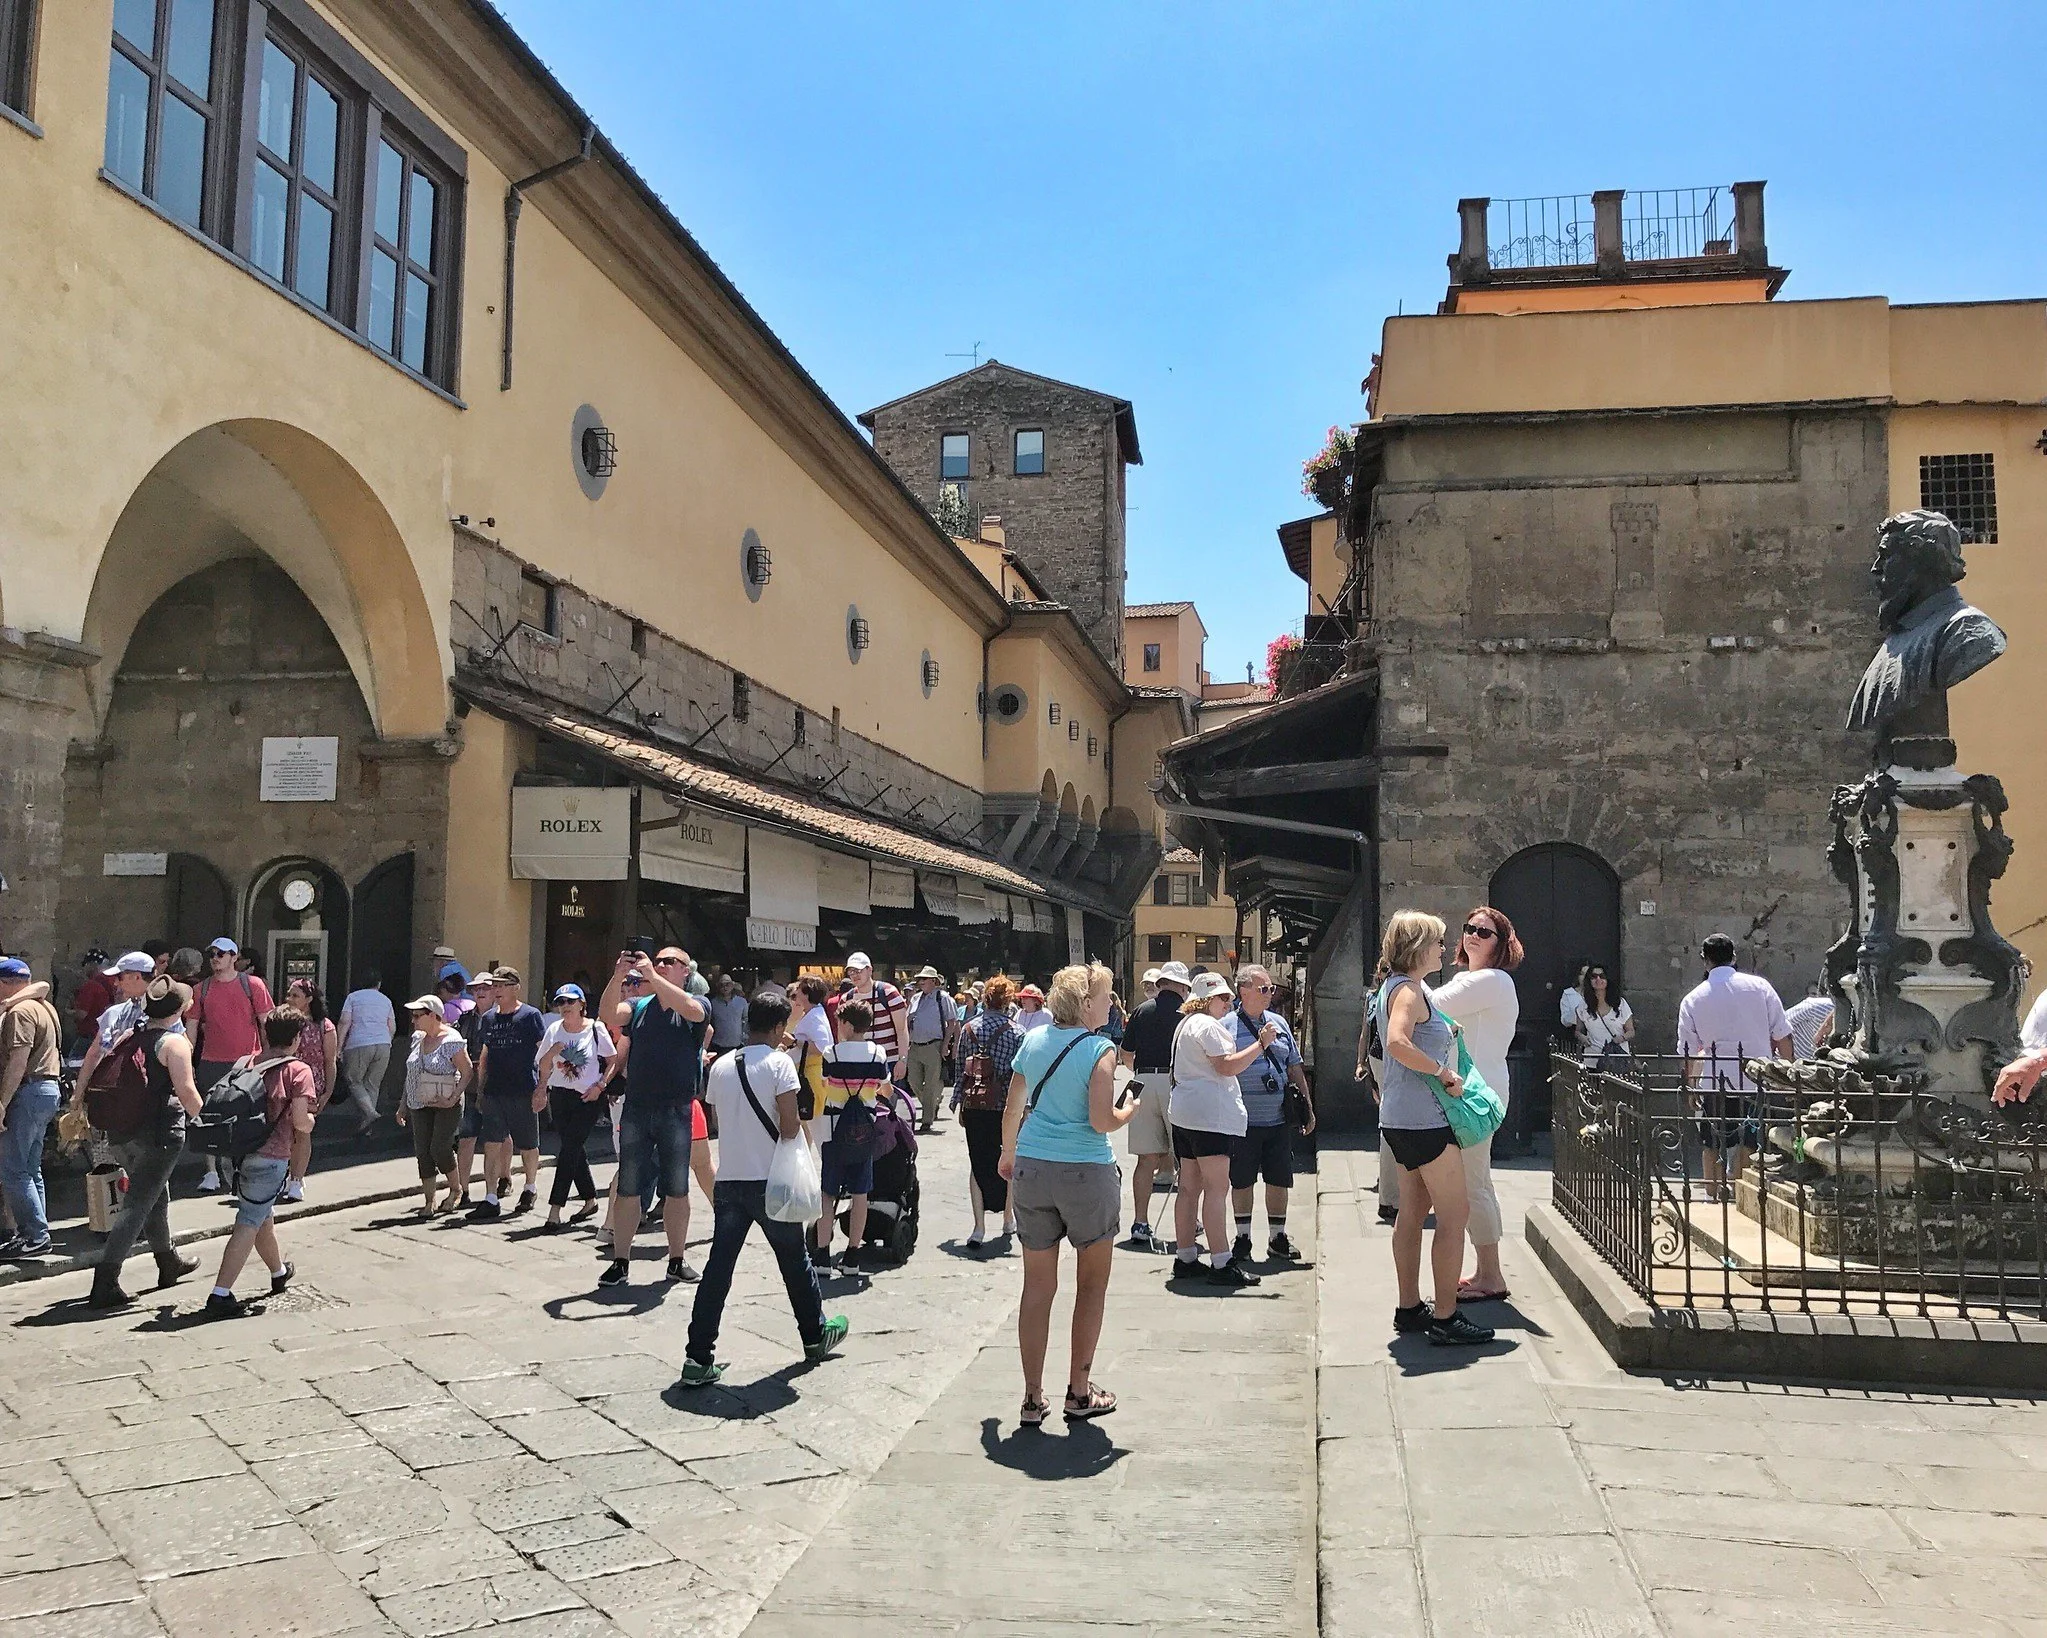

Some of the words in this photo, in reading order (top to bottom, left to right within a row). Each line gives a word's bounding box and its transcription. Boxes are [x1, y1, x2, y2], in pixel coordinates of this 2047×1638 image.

[540, 819, 603, 833] ROLEX
[680, 823, 713, 846] ROLEX
[750, 923, 779, 945] CARLO
